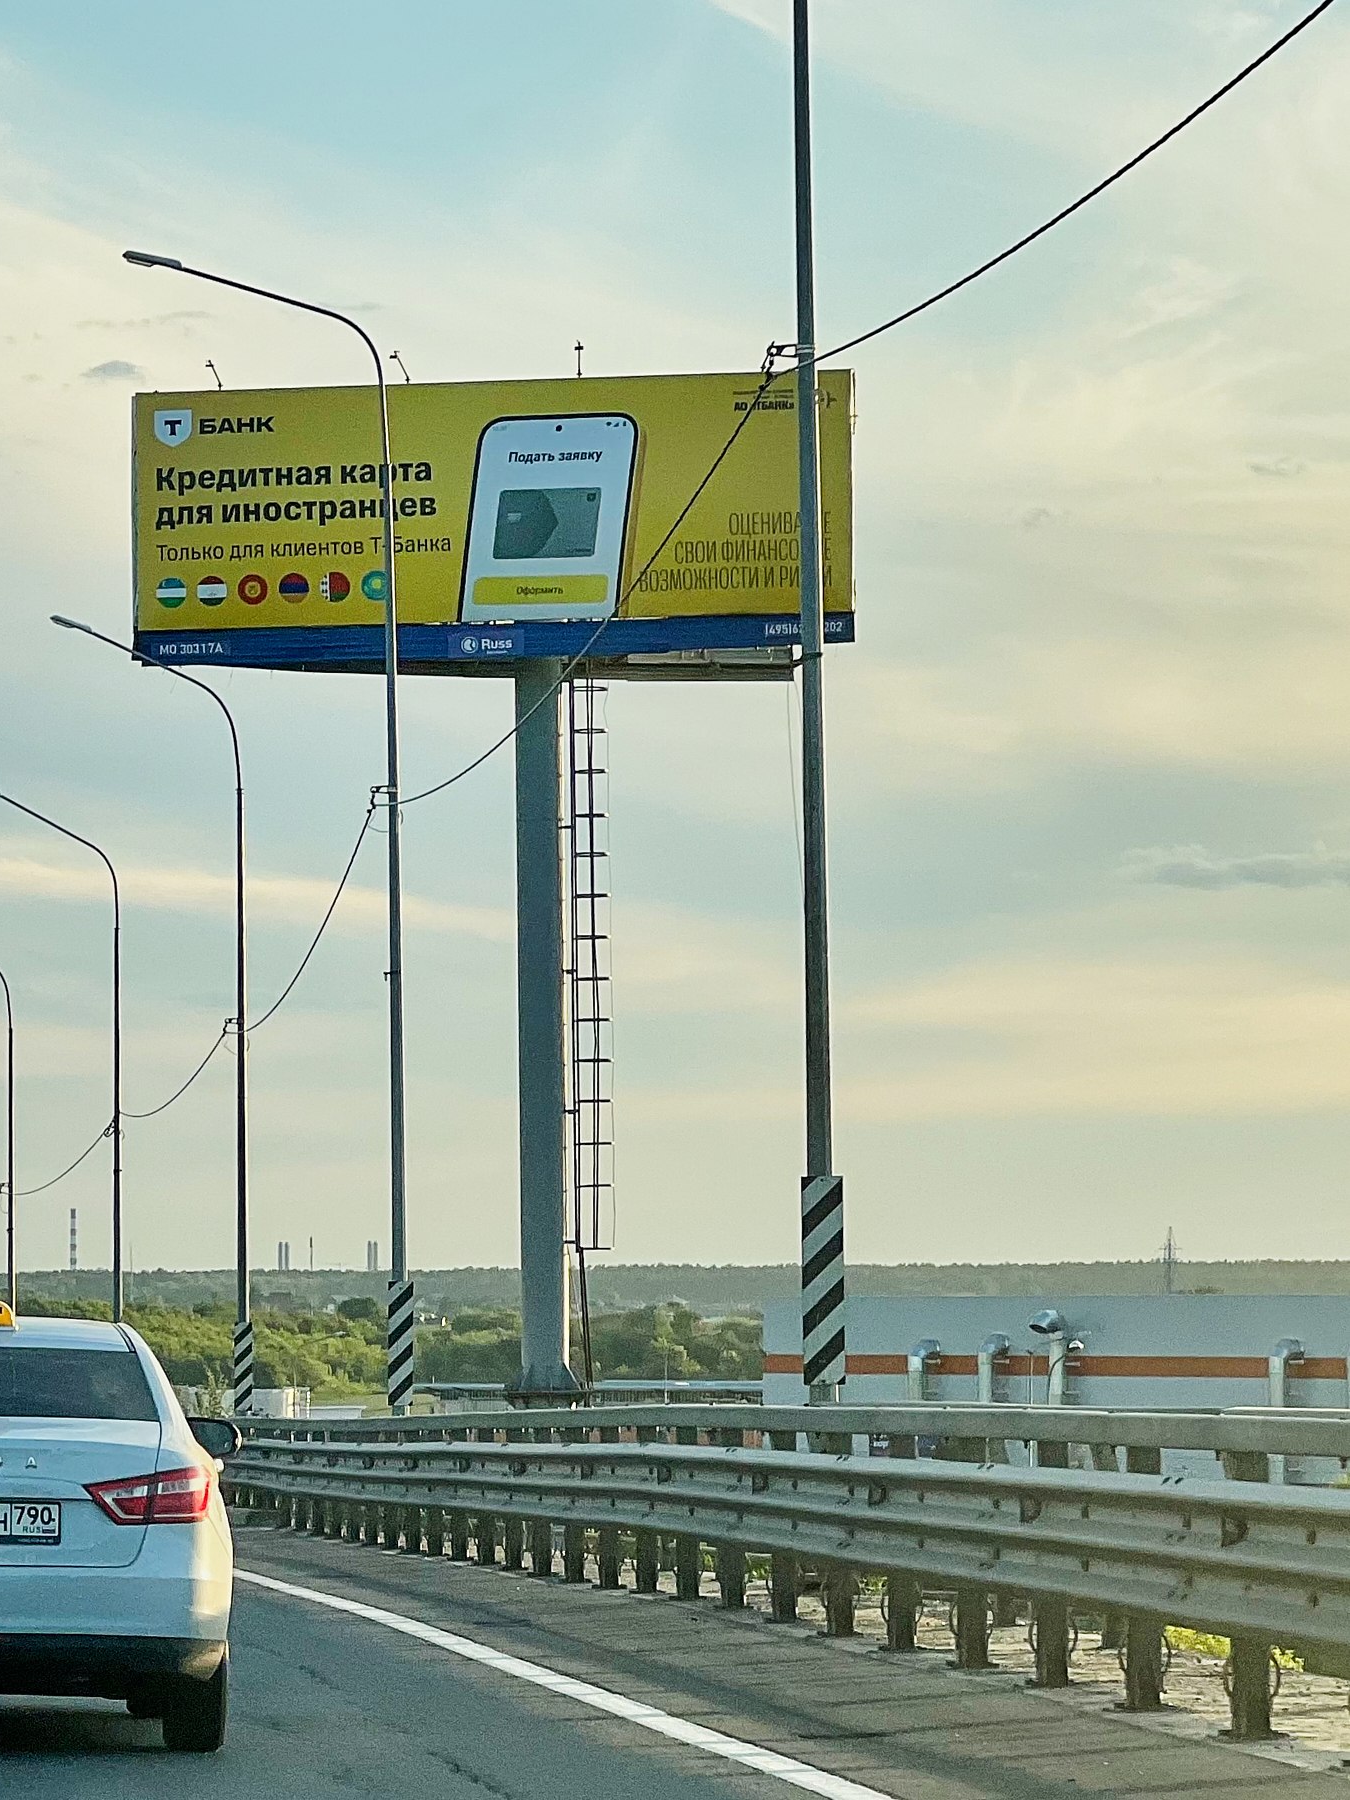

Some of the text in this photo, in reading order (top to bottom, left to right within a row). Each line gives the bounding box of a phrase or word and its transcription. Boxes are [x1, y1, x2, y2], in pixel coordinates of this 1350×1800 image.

[164, 416, 275, 436] Т БАНК
[508, 451, 603, 464] Подать заявку
[156, 462, 432, 496] Кредитная карта
[155, 497, 437, 530] для иностранцев
[729, 511, 832, 538] ОЦЕНИВАЕ
[157, 536, 451, 562] Только для клиентов Т-Банка
[674, 538, 832, 564] СВОИ ФИНАНСОЕ
[639, 565, 832, 592] ВОЗМОЖНОСТИ И РИИ
[159, 645, 177, 655] МО
[481, 638, 513, 651] Russ
[14, 1505, 52, 1526] 790
[22, 1526, 41, 1534] RUS
